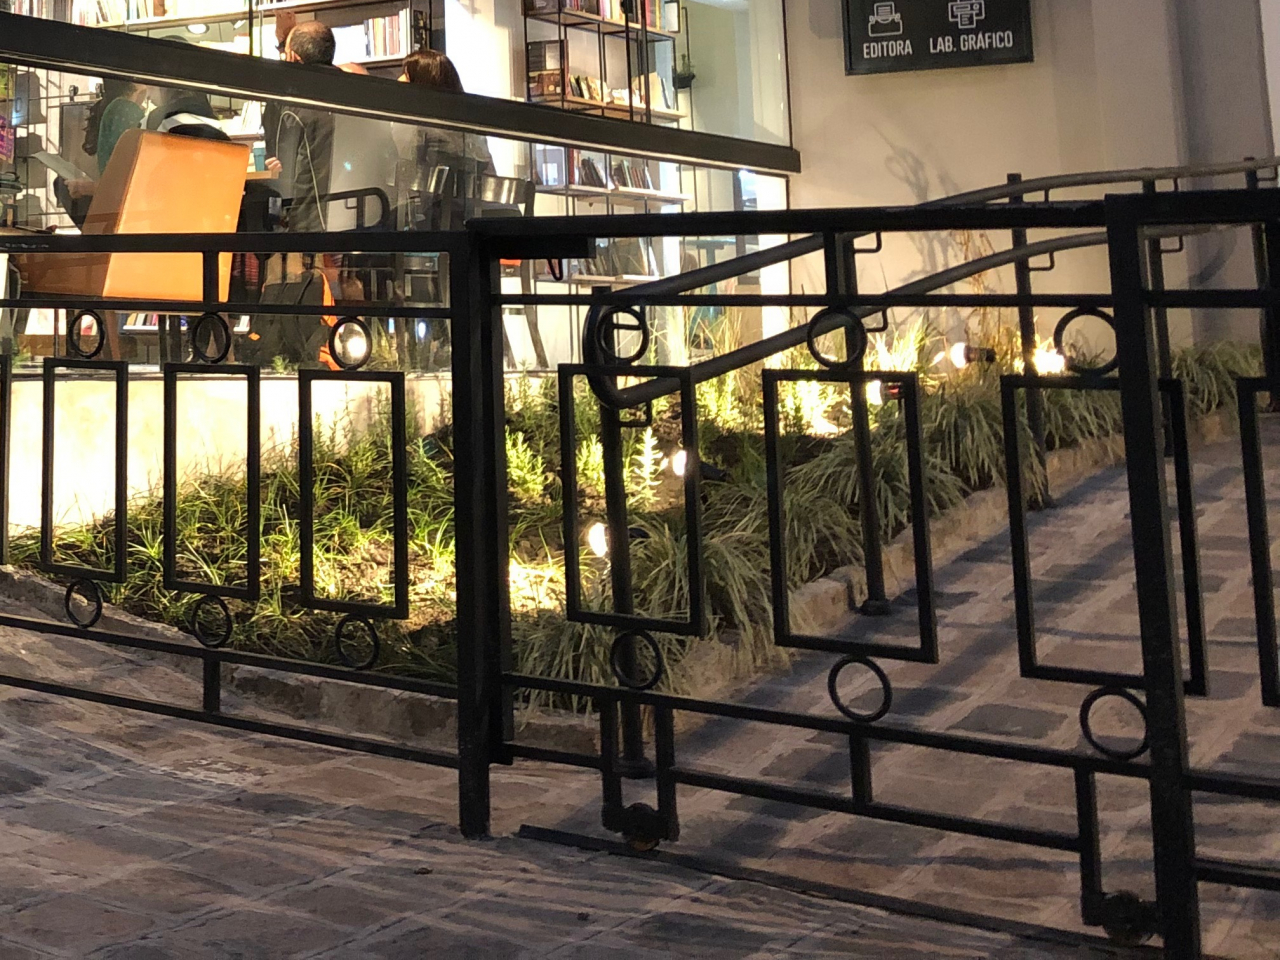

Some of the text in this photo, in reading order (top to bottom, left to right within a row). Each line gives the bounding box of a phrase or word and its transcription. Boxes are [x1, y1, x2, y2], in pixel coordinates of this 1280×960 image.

[863, 39, 913, 59] EDITORA
[929, 30, 1013, 54] LAB. GRÁFICO
